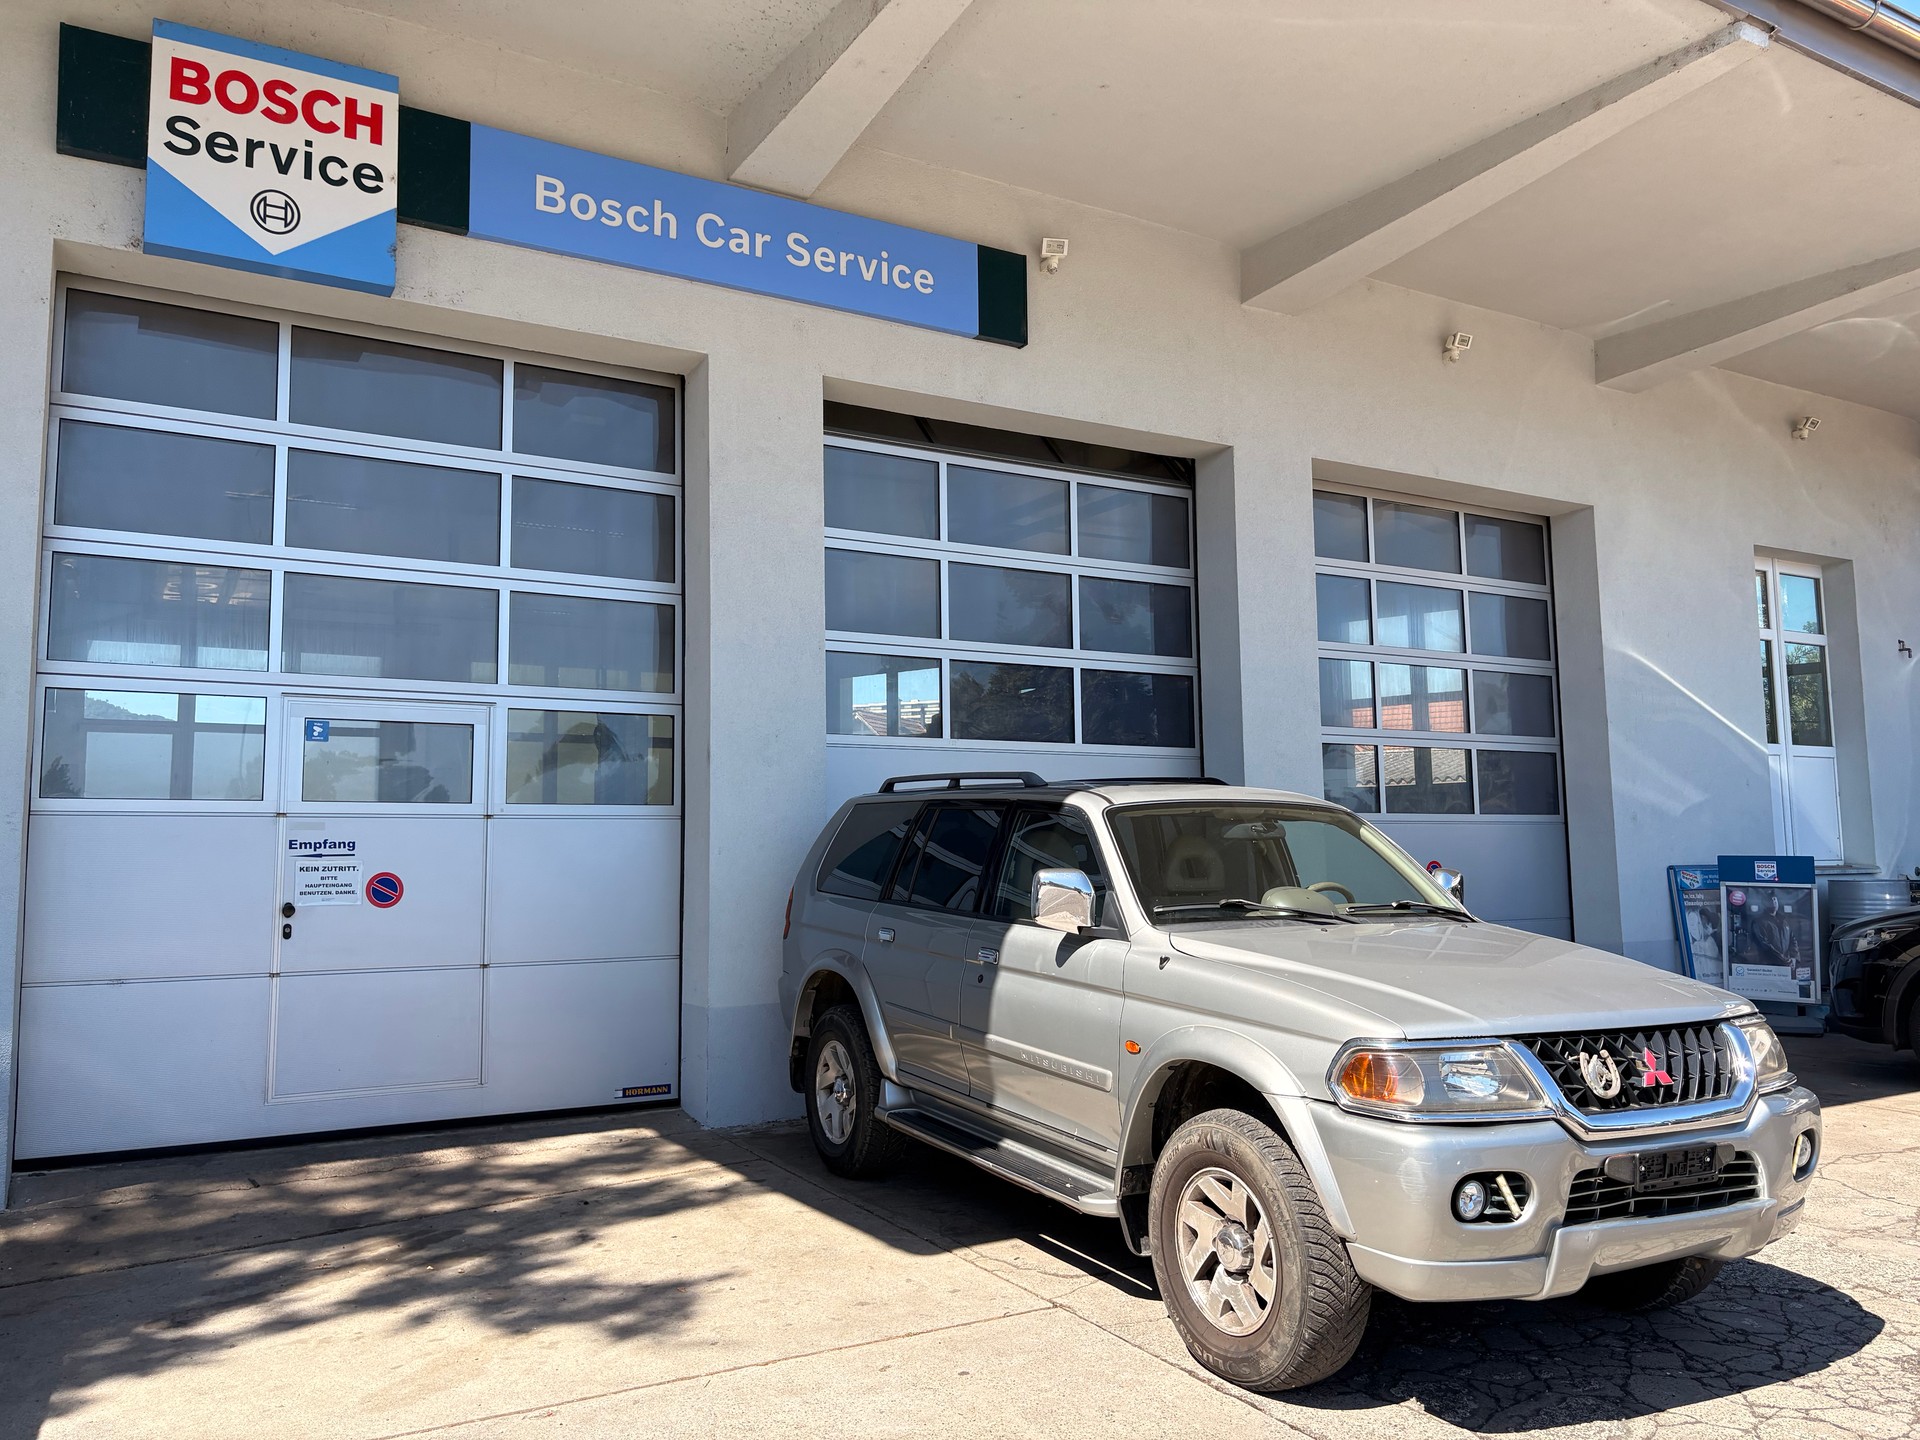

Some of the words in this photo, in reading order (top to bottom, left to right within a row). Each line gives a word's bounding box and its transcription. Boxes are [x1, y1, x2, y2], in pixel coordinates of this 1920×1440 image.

[169, 56, 383, 146] BOSCH
[163, 115, 384, 194] Service
[535, 174, 678, 240] Bosch
[695, 213, 771, 258] Car
[786, 232, 935, 295] Service
[288, 839, 356, 852] Empfang
[321, 865, 359, 873] ZUTRITT.
[1020, 1050, 1100, 1084] MITSUBISHI
